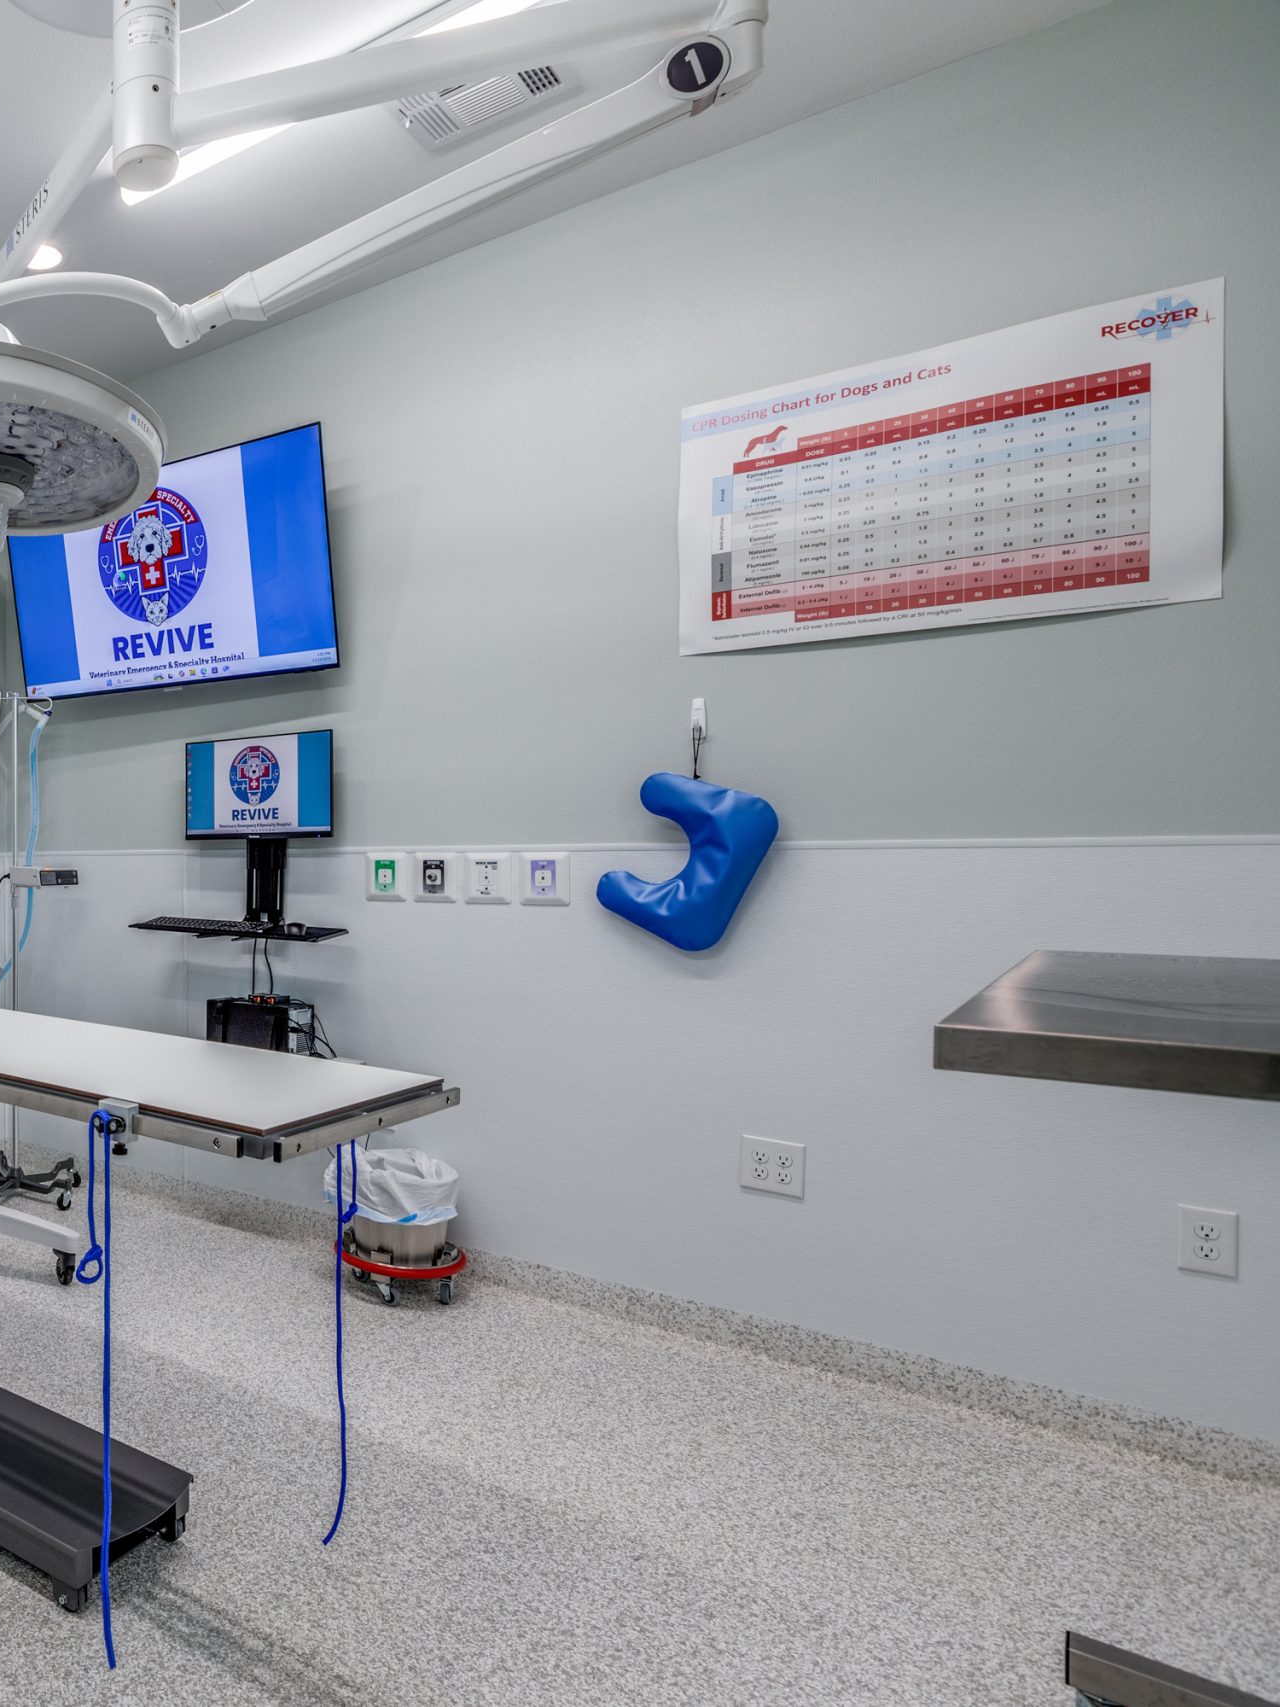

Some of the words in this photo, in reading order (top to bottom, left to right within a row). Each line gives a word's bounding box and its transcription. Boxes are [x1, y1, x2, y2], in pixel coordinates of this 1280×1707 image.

[684, 48, 707, 86] 1
[16, 180, 49, 243] STERIS
[1101, 307, 1198, 337] RECOVER
[1127, 369, 1141, 377] 100
[692, 417, 717, 432] CPR
[721, 407, 768, 427] Dosing
[772, 398, 811, 414] Chart
[814, 391, 836, 405] for
[841, 381, 878, 399] Dogs
[882, 372, 912, 389] and
[917, 364, 952, 380] Cats
[156, 490, 195, 523] SPECIALTY
[112, 622, 214, 661] REVIVE
[232, 808, 279, 821] REVIVE
